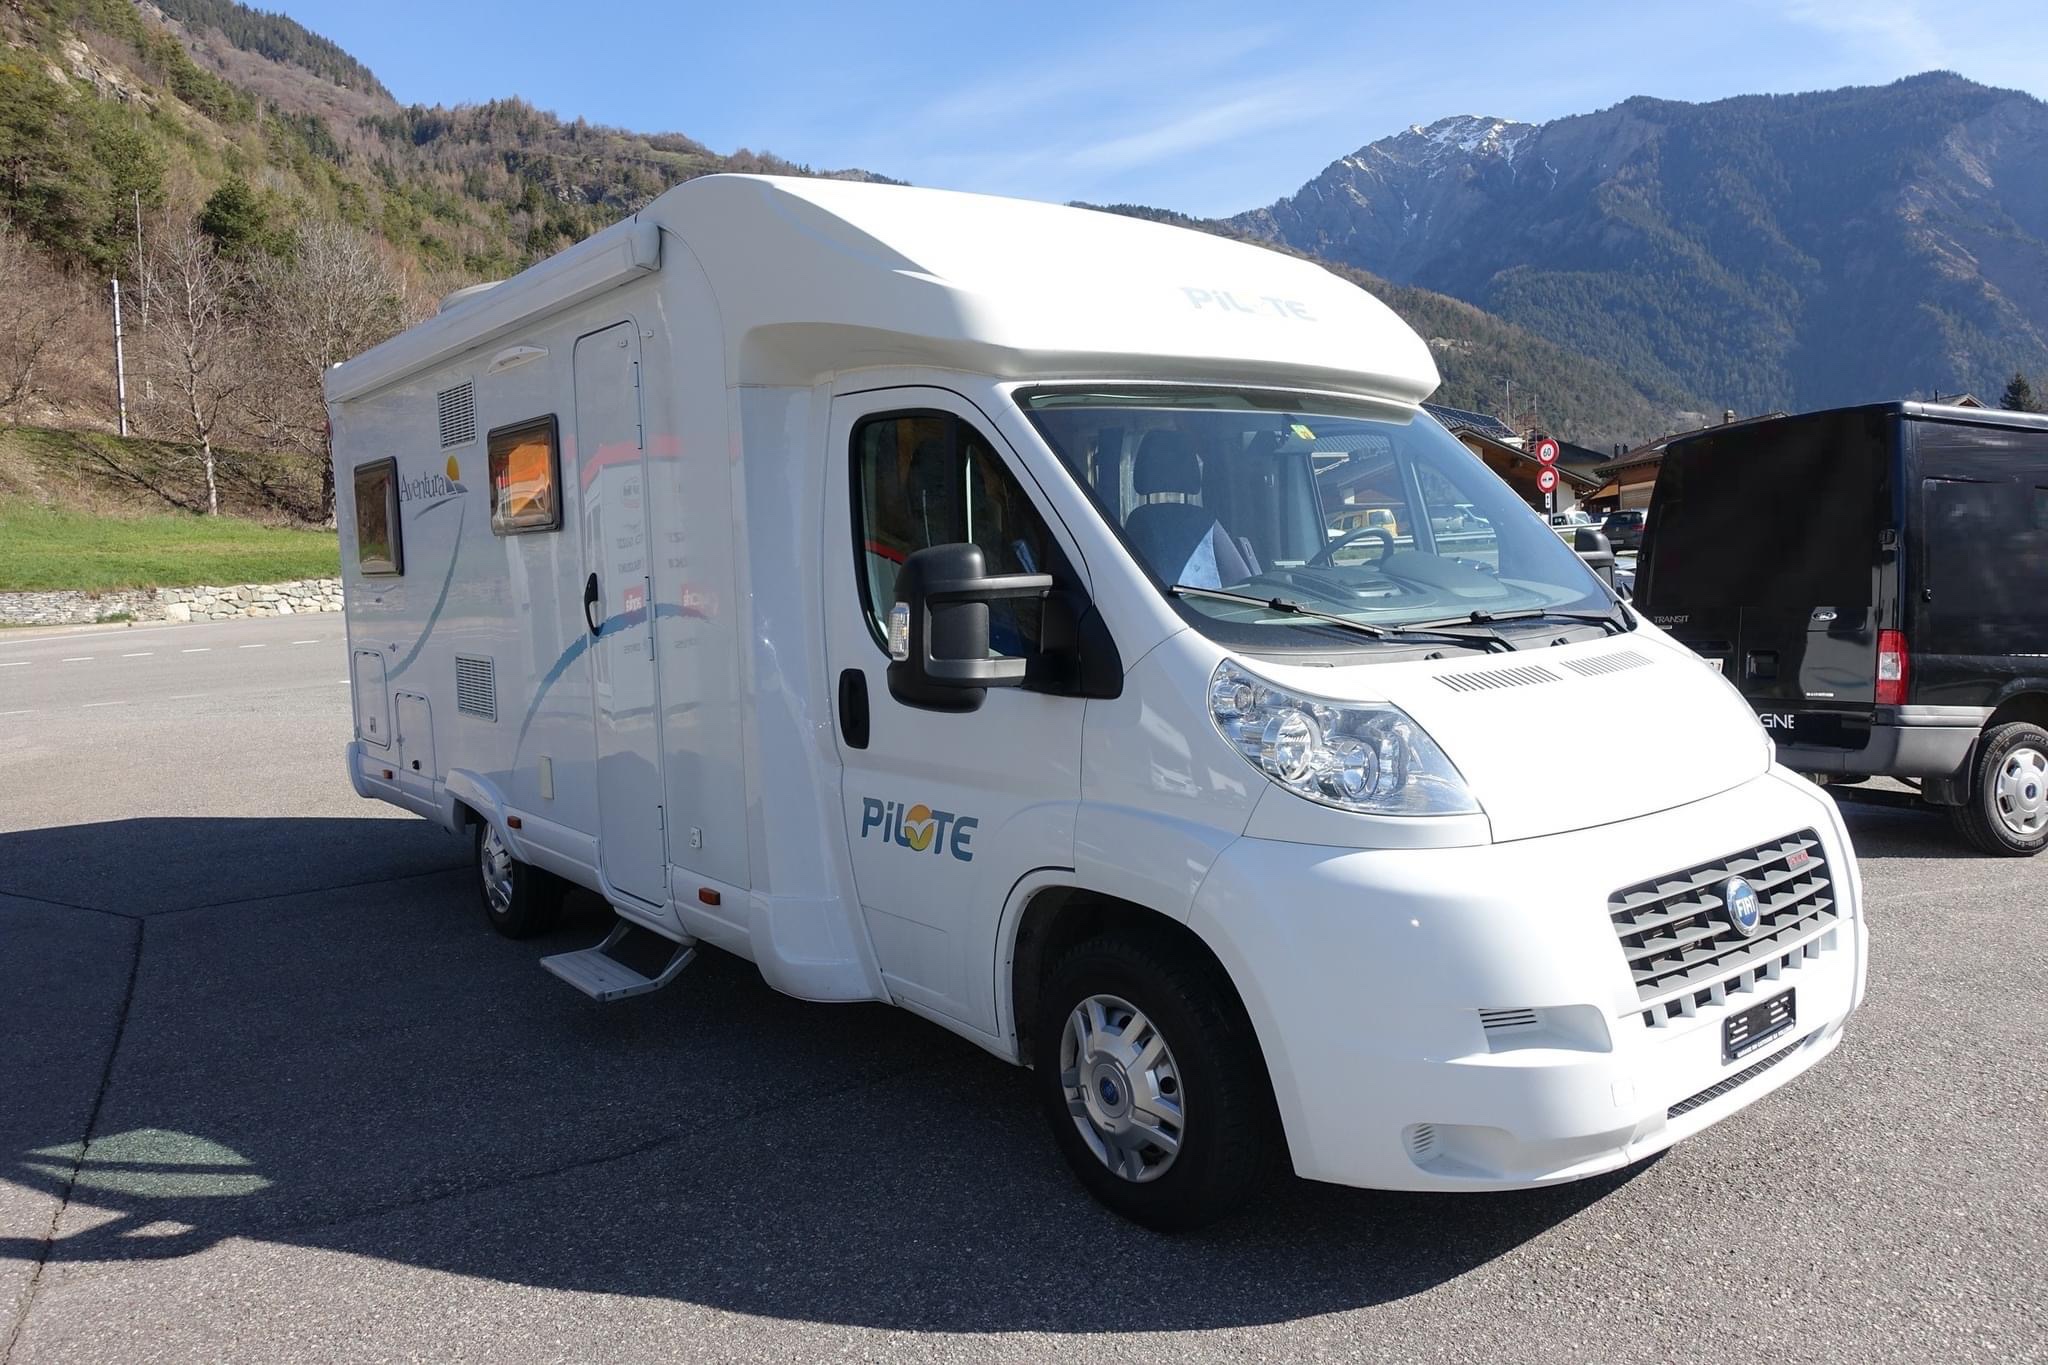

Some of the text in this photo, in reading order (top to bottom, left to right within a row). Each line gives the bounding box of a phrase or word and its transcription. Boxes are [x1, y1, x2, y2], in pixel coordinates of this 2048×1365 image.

[1543, 447, 1552, 457] 60
[400, 471, 446, 502] Aventura
[1654, 615, 1689, 623] TRANSIT
[1735, 895, 1756, 918] FIAT
